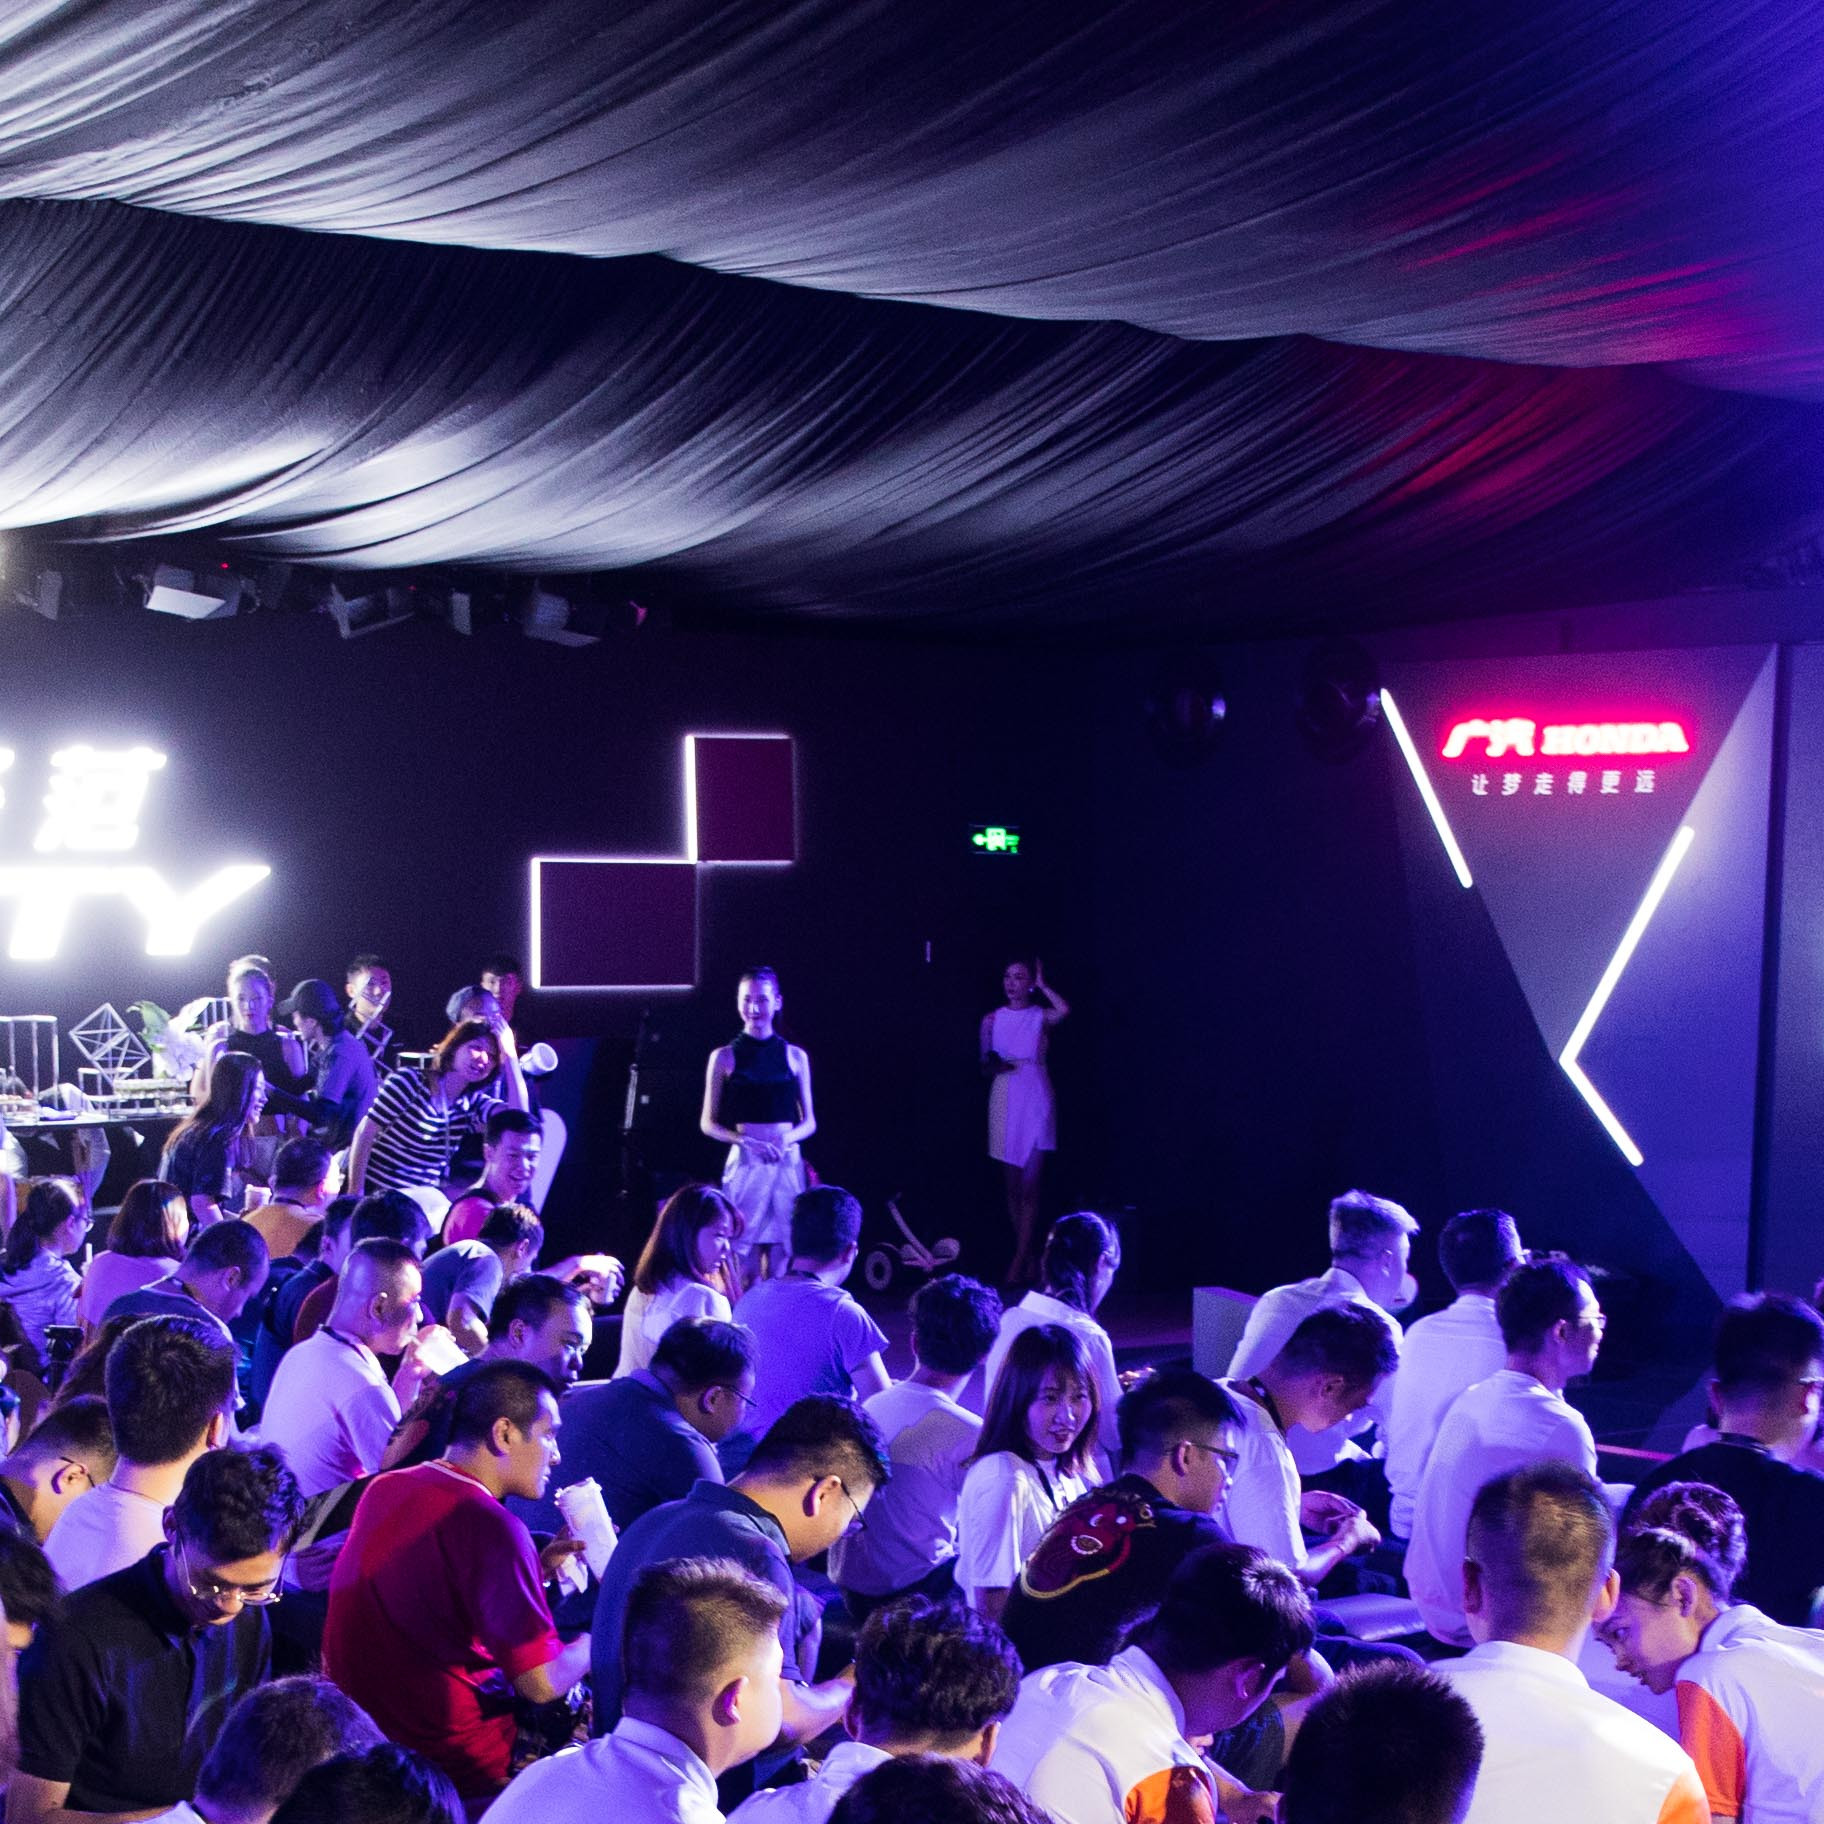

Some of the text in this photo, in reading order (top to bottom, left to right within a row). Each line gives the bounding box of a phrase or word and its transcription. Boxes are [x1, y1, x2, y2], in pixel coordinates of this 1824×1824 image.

[1540, 722, 1690, 756] HONDA
[1470, 769, 1656, 796] 让梦走得更远
